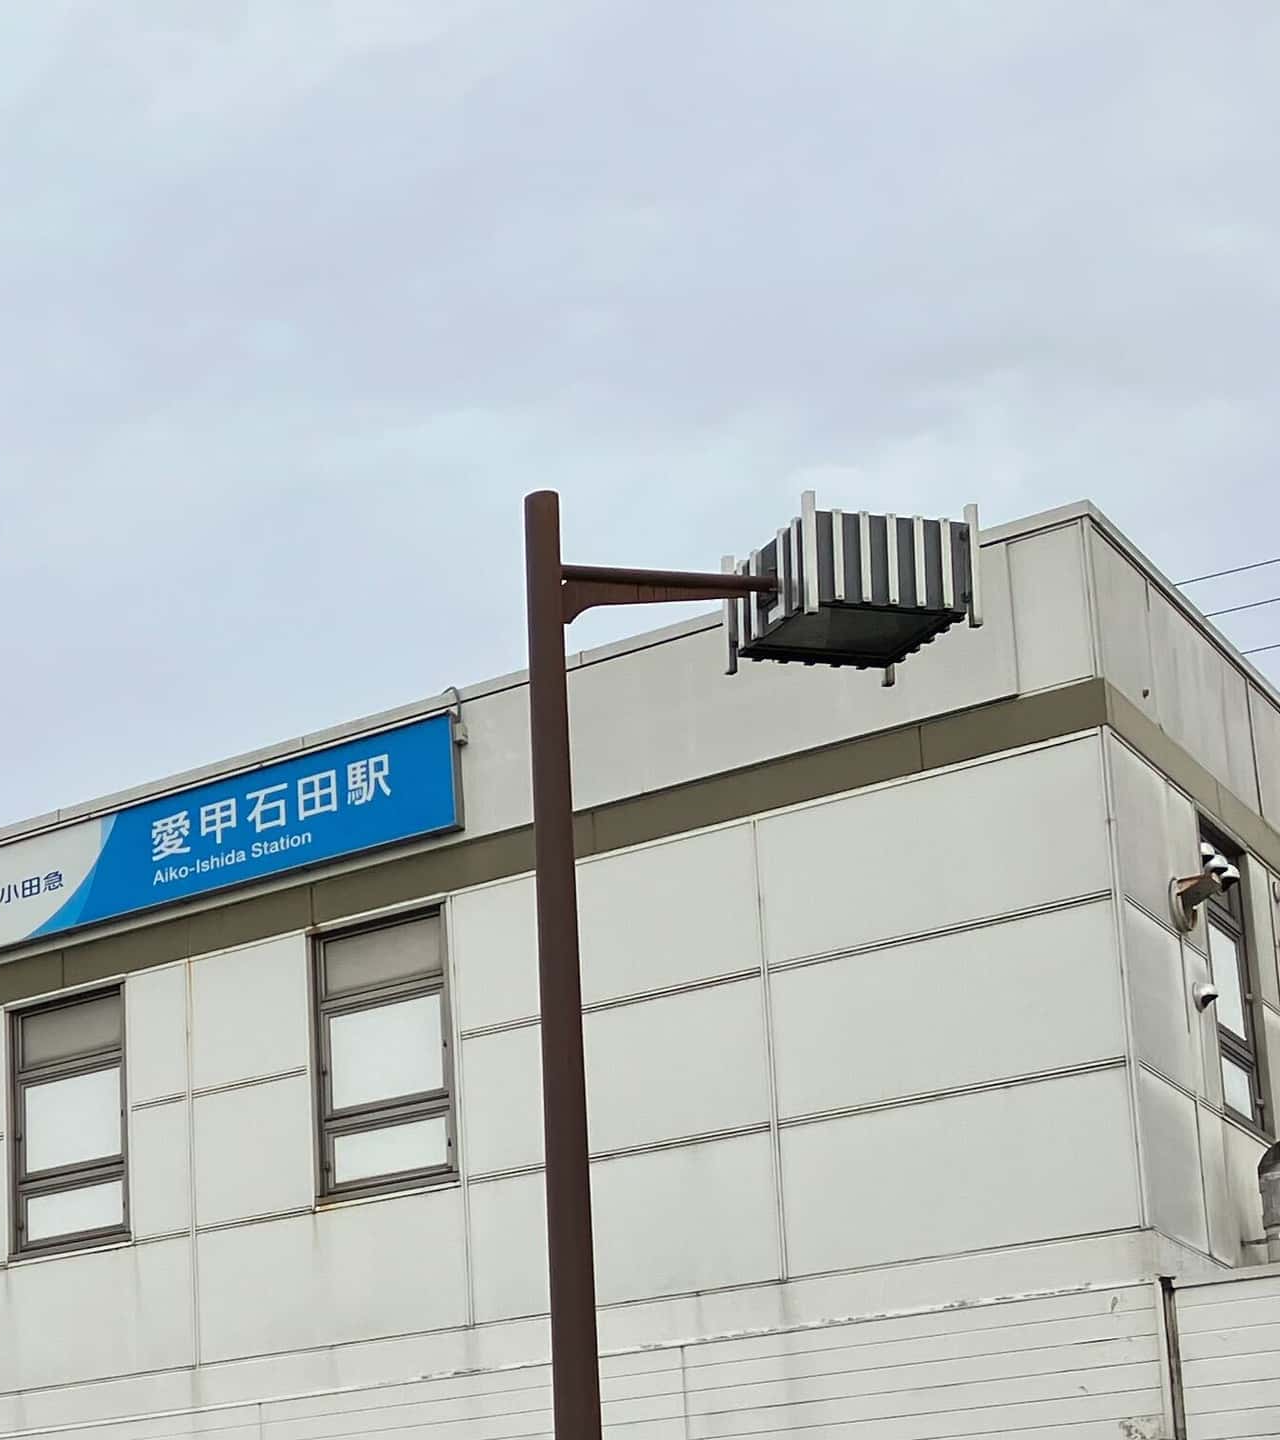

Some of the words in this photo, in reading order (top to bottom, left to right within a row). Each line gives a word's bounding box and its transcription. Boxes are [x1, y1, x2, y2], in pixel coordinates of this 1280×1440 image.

[151, 753, 391, 862] 愛甲石田駅
[152, 848, 246, 886] Aiko-Ishida
[251, 830, 312, 861] Station
